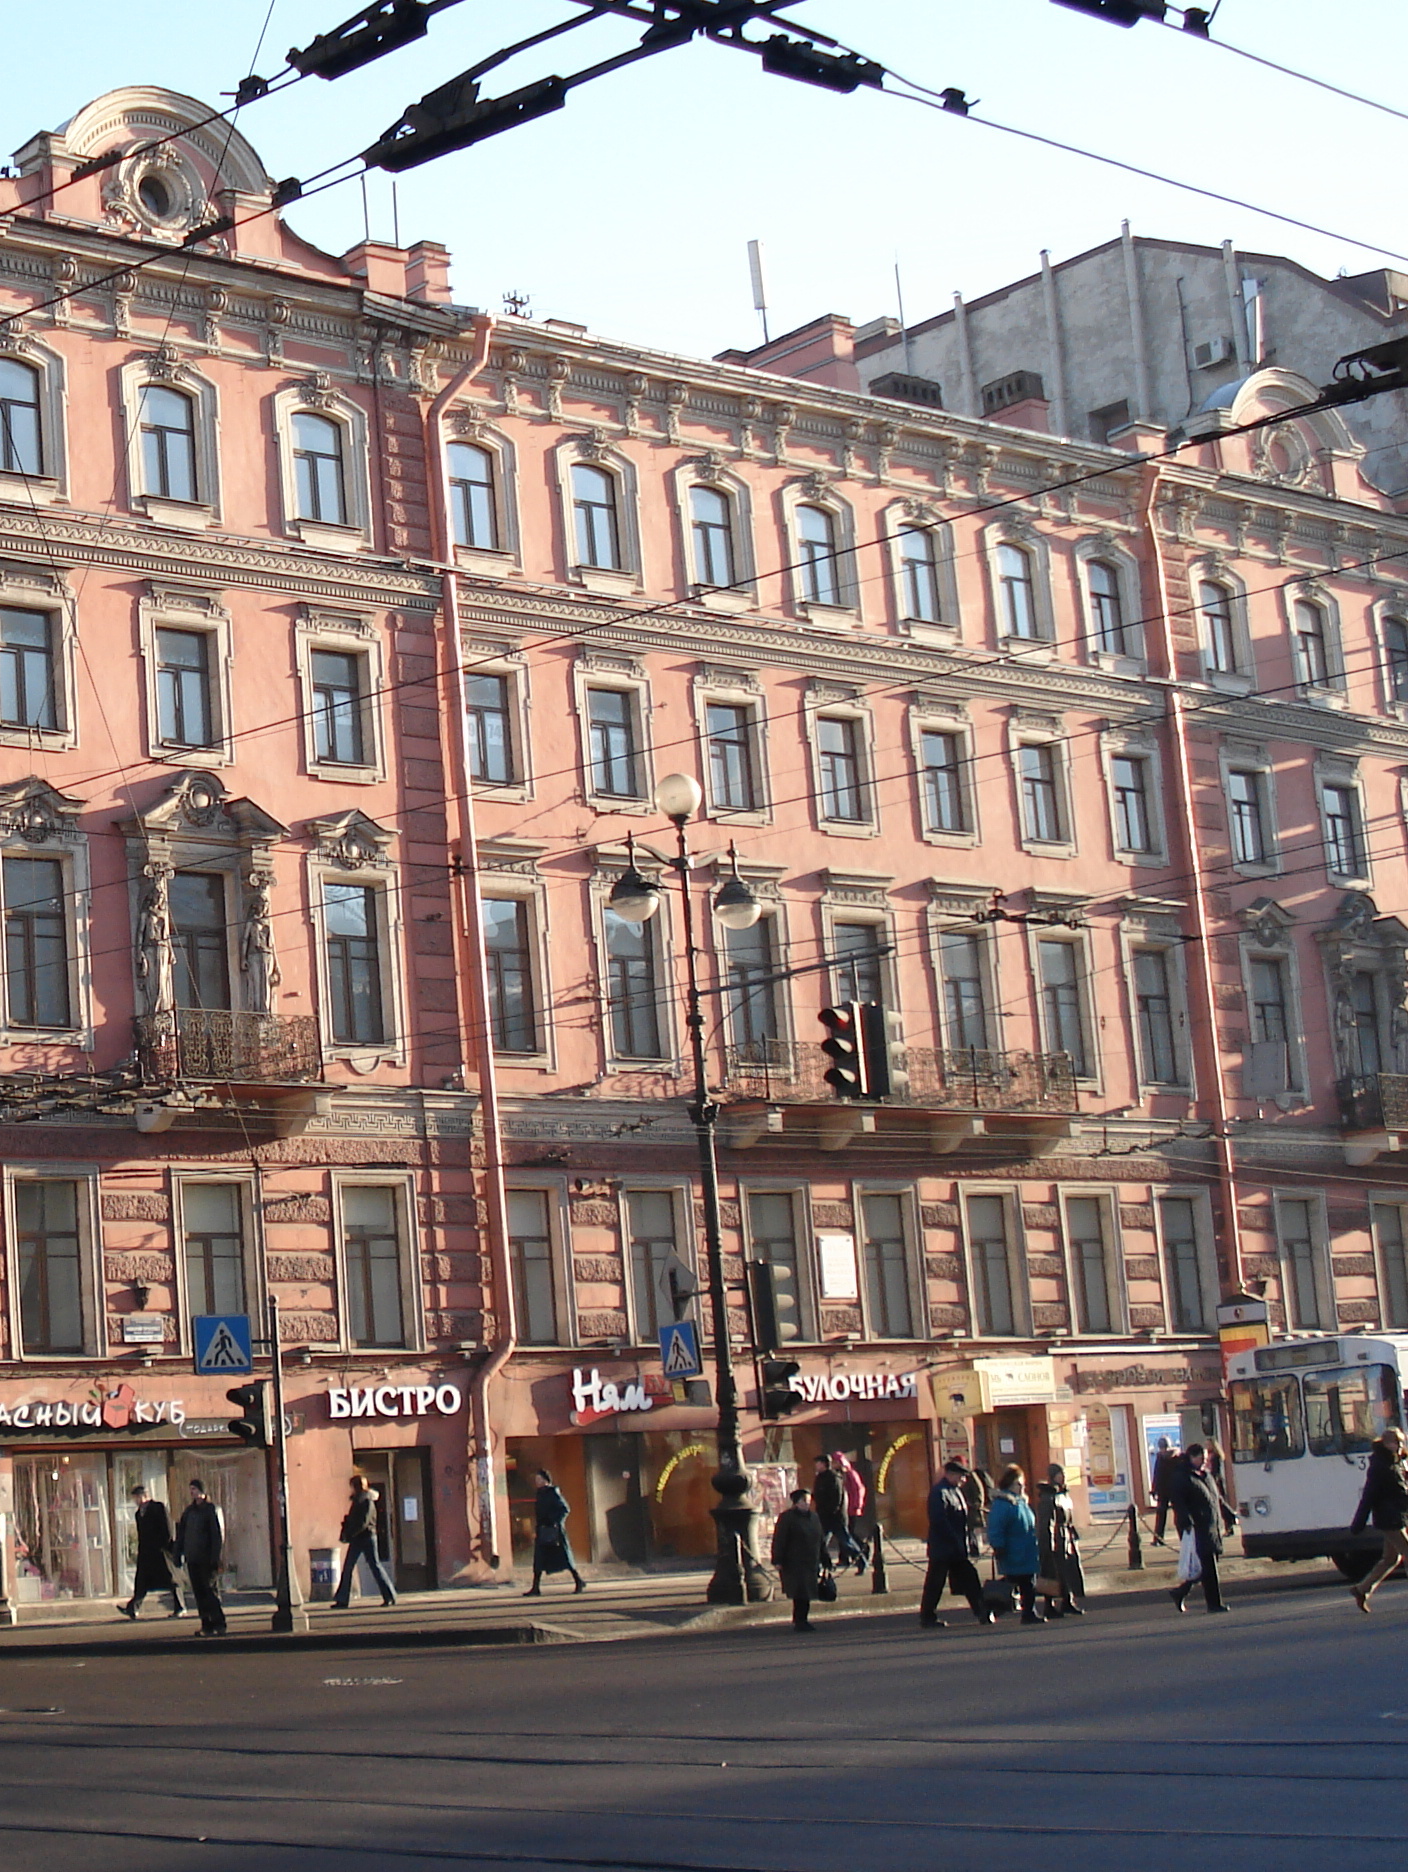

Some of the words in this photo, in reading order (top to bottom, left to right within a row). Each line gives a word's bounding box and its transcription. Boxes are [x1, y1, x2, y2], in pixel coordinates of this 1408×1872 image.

[328, 1384, 461, 1418] БИСТРО
[572, 1368, 653, 1412] Ням
[788, 1372, 918, 1402] БУЛОЧНАЯ
[135, 1400, 186, 1424] КУБ
